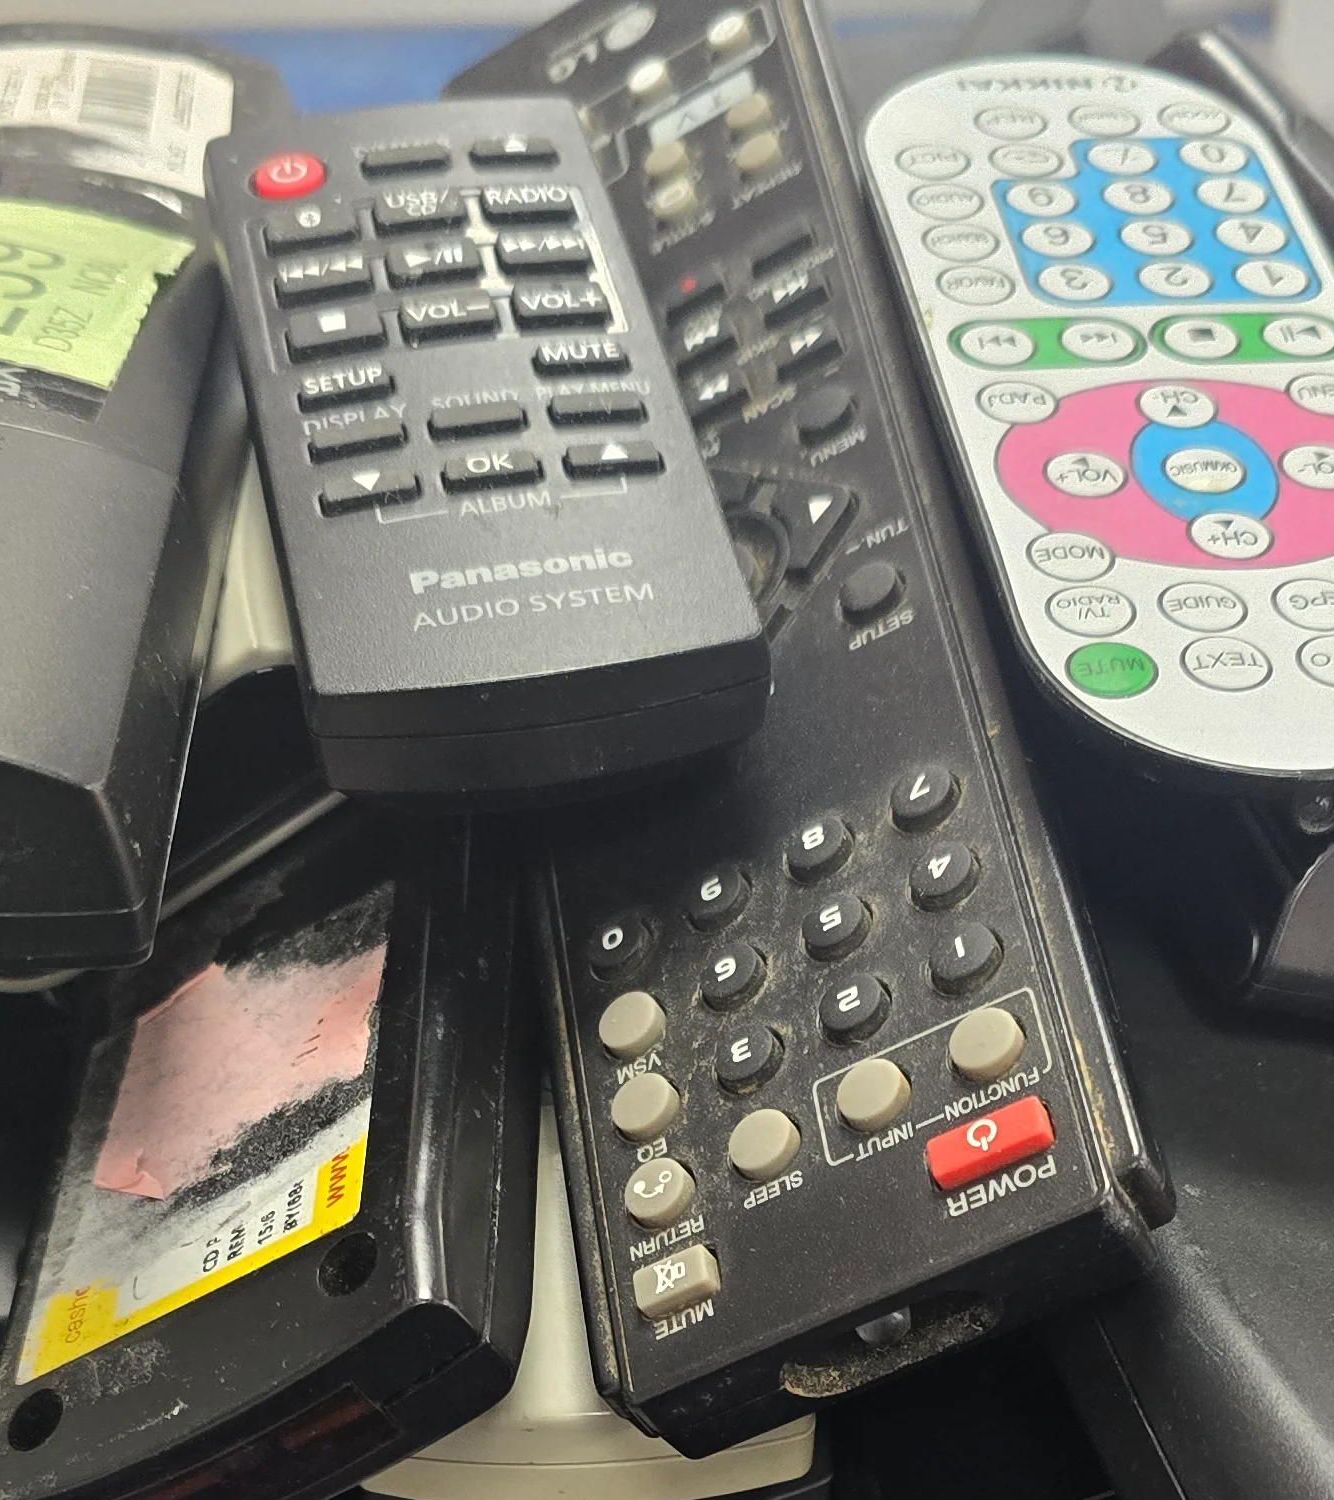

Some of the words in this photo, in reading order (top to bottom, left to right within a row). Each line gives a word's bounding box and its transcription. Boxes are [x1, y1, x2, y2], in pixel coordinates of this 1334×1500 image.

[957, 75, 1093, 93] NIKKAI
[1202, 145, 1224, 163] 0
[484, 187, 568, 205] RADIO
[1027, 189, 1053, 207] 9
[1128, 185, 1153, 204] 8
[1224, 184, 1246, 202] 7
[1044, 226, 1070, 245] 6
[1142, 225, 1168, 244] 5
[1241, 224, 1267, 243] 4
[1059, 268, 1087, 289] 3
[1163, 267, 1192, 287] 2
[1264, 266, 1283, 287] 1
[520, 290, 603, 311] VOL+
[541, 341, 620, 361] MUTE
[304, 366, 383, 394] SETUP
[304, 403, 407, 436] DISPLAY
[810, 428, 867, 467] MENU
[467, 452, 514, 473] OK
[1056, 469, 1118, 483] VOL+
[460, 491, 552, 516] ALBUM
[1206, 530, 1259, 546] CH+
[1037, 545, 1105, 562] MODE
[410, 547, 633, 594] Panasonic
[412, 598, 520, 632] AUDIO
[532, 583, 655, 613] SYSTEM
[1057, 595, 1120, 608] RADIO
[1168, 596, 1237, 612] GUIDE
[849, 609, 916, 651] SETUP
[1078, 658, 1146, 676] MUTE
[1193, 653, 1264, 671] TEXT
[910, 775, 930, 800] 7
[801, 827, 824, 849] 8
[928, 856, 952, 879] 4
[702, 879, 722, 900] 9
[819, 907, 842, 929] 5
[603, 930, 623, 950] 0
[954, 937, 965, 958] 1
[715, 958, 736, 981] 6
[837, 987, 860, 1010] 2
[730, 1038, 751, 1062] 3
[617, 1052, 662, 1084] VSM
[857, 1123, 913, 1162] INPUT
[945, 1067, 1041, 1118] FUNCTION
[636, 1137, 667, 1160] EQ
[743, 1171, 804, 1208] SLEEP
[946, 1155, 1057, 1217] POWER
[227, 1221, 246, 1261] REM
[629, 1215, 704, 1260] RETURN
[655, 1299, 713, 1339] MUTE
